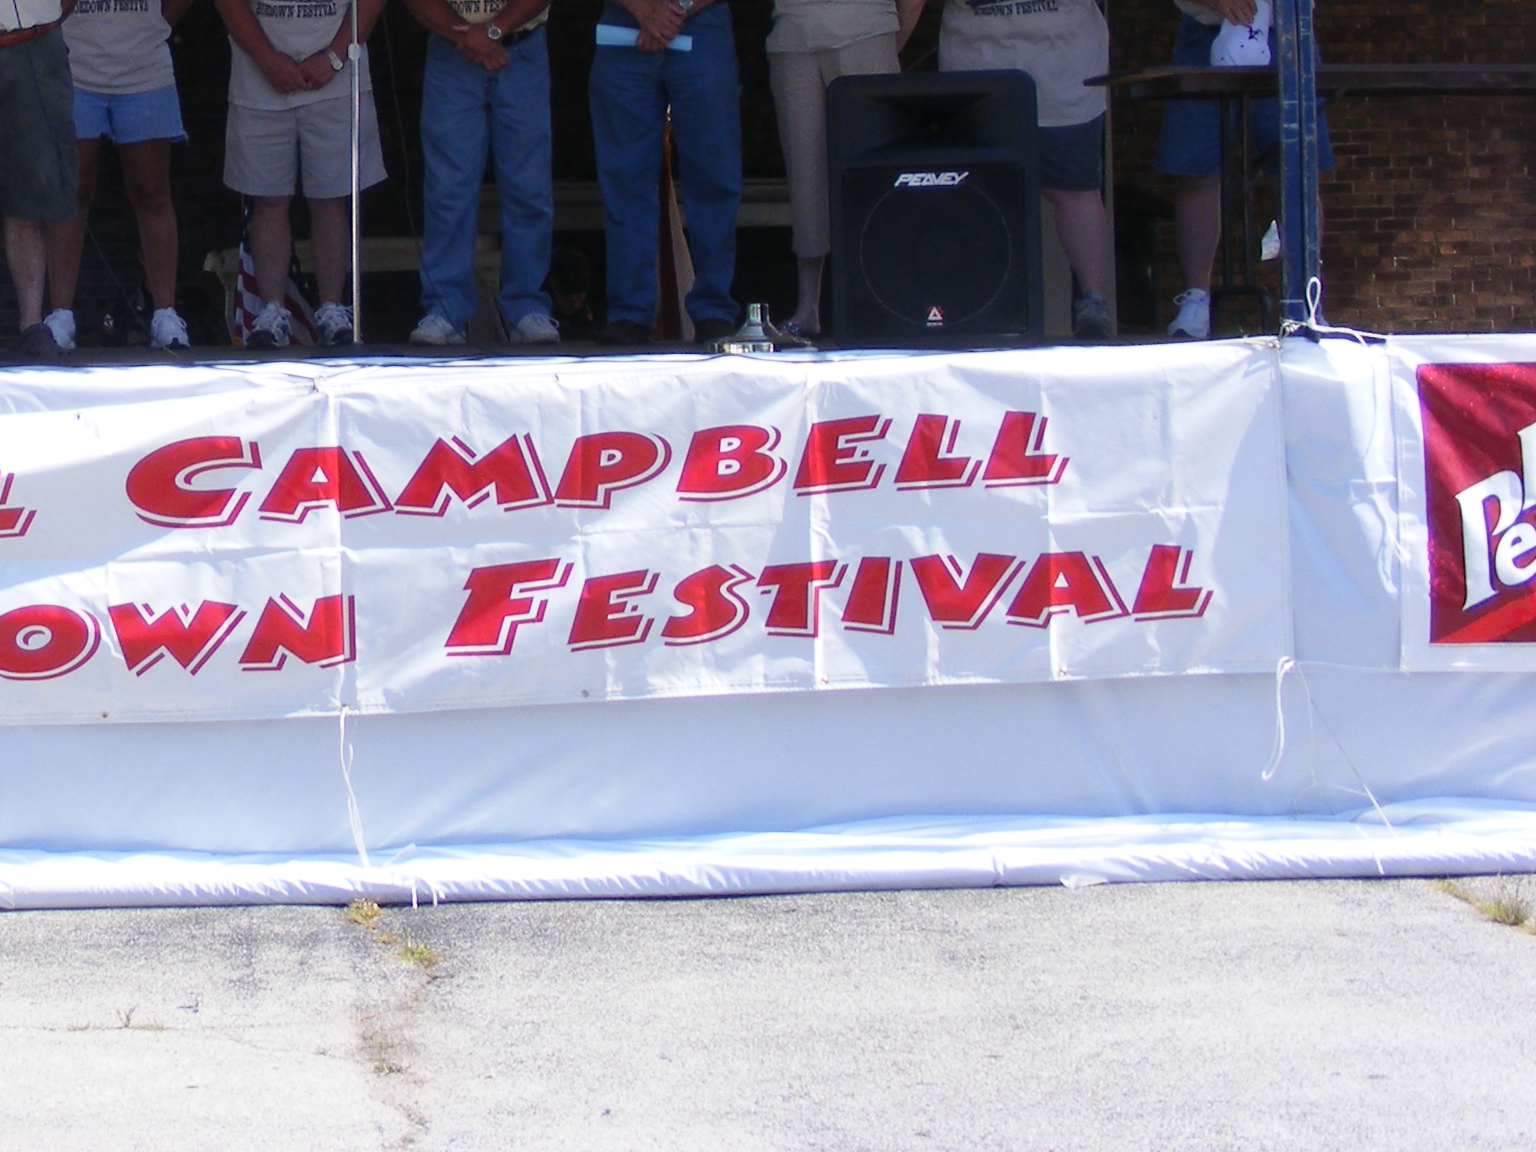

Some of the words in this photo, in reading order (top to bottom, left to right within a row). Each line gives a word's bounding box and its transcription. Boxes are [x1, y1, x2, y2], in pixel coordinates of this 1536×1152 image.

[894, 171, 969, 187] PEAVEY
[124, 410, 1071, 529] CAMPBELL
[444, 543, 1217, 658] FESTIVAL
